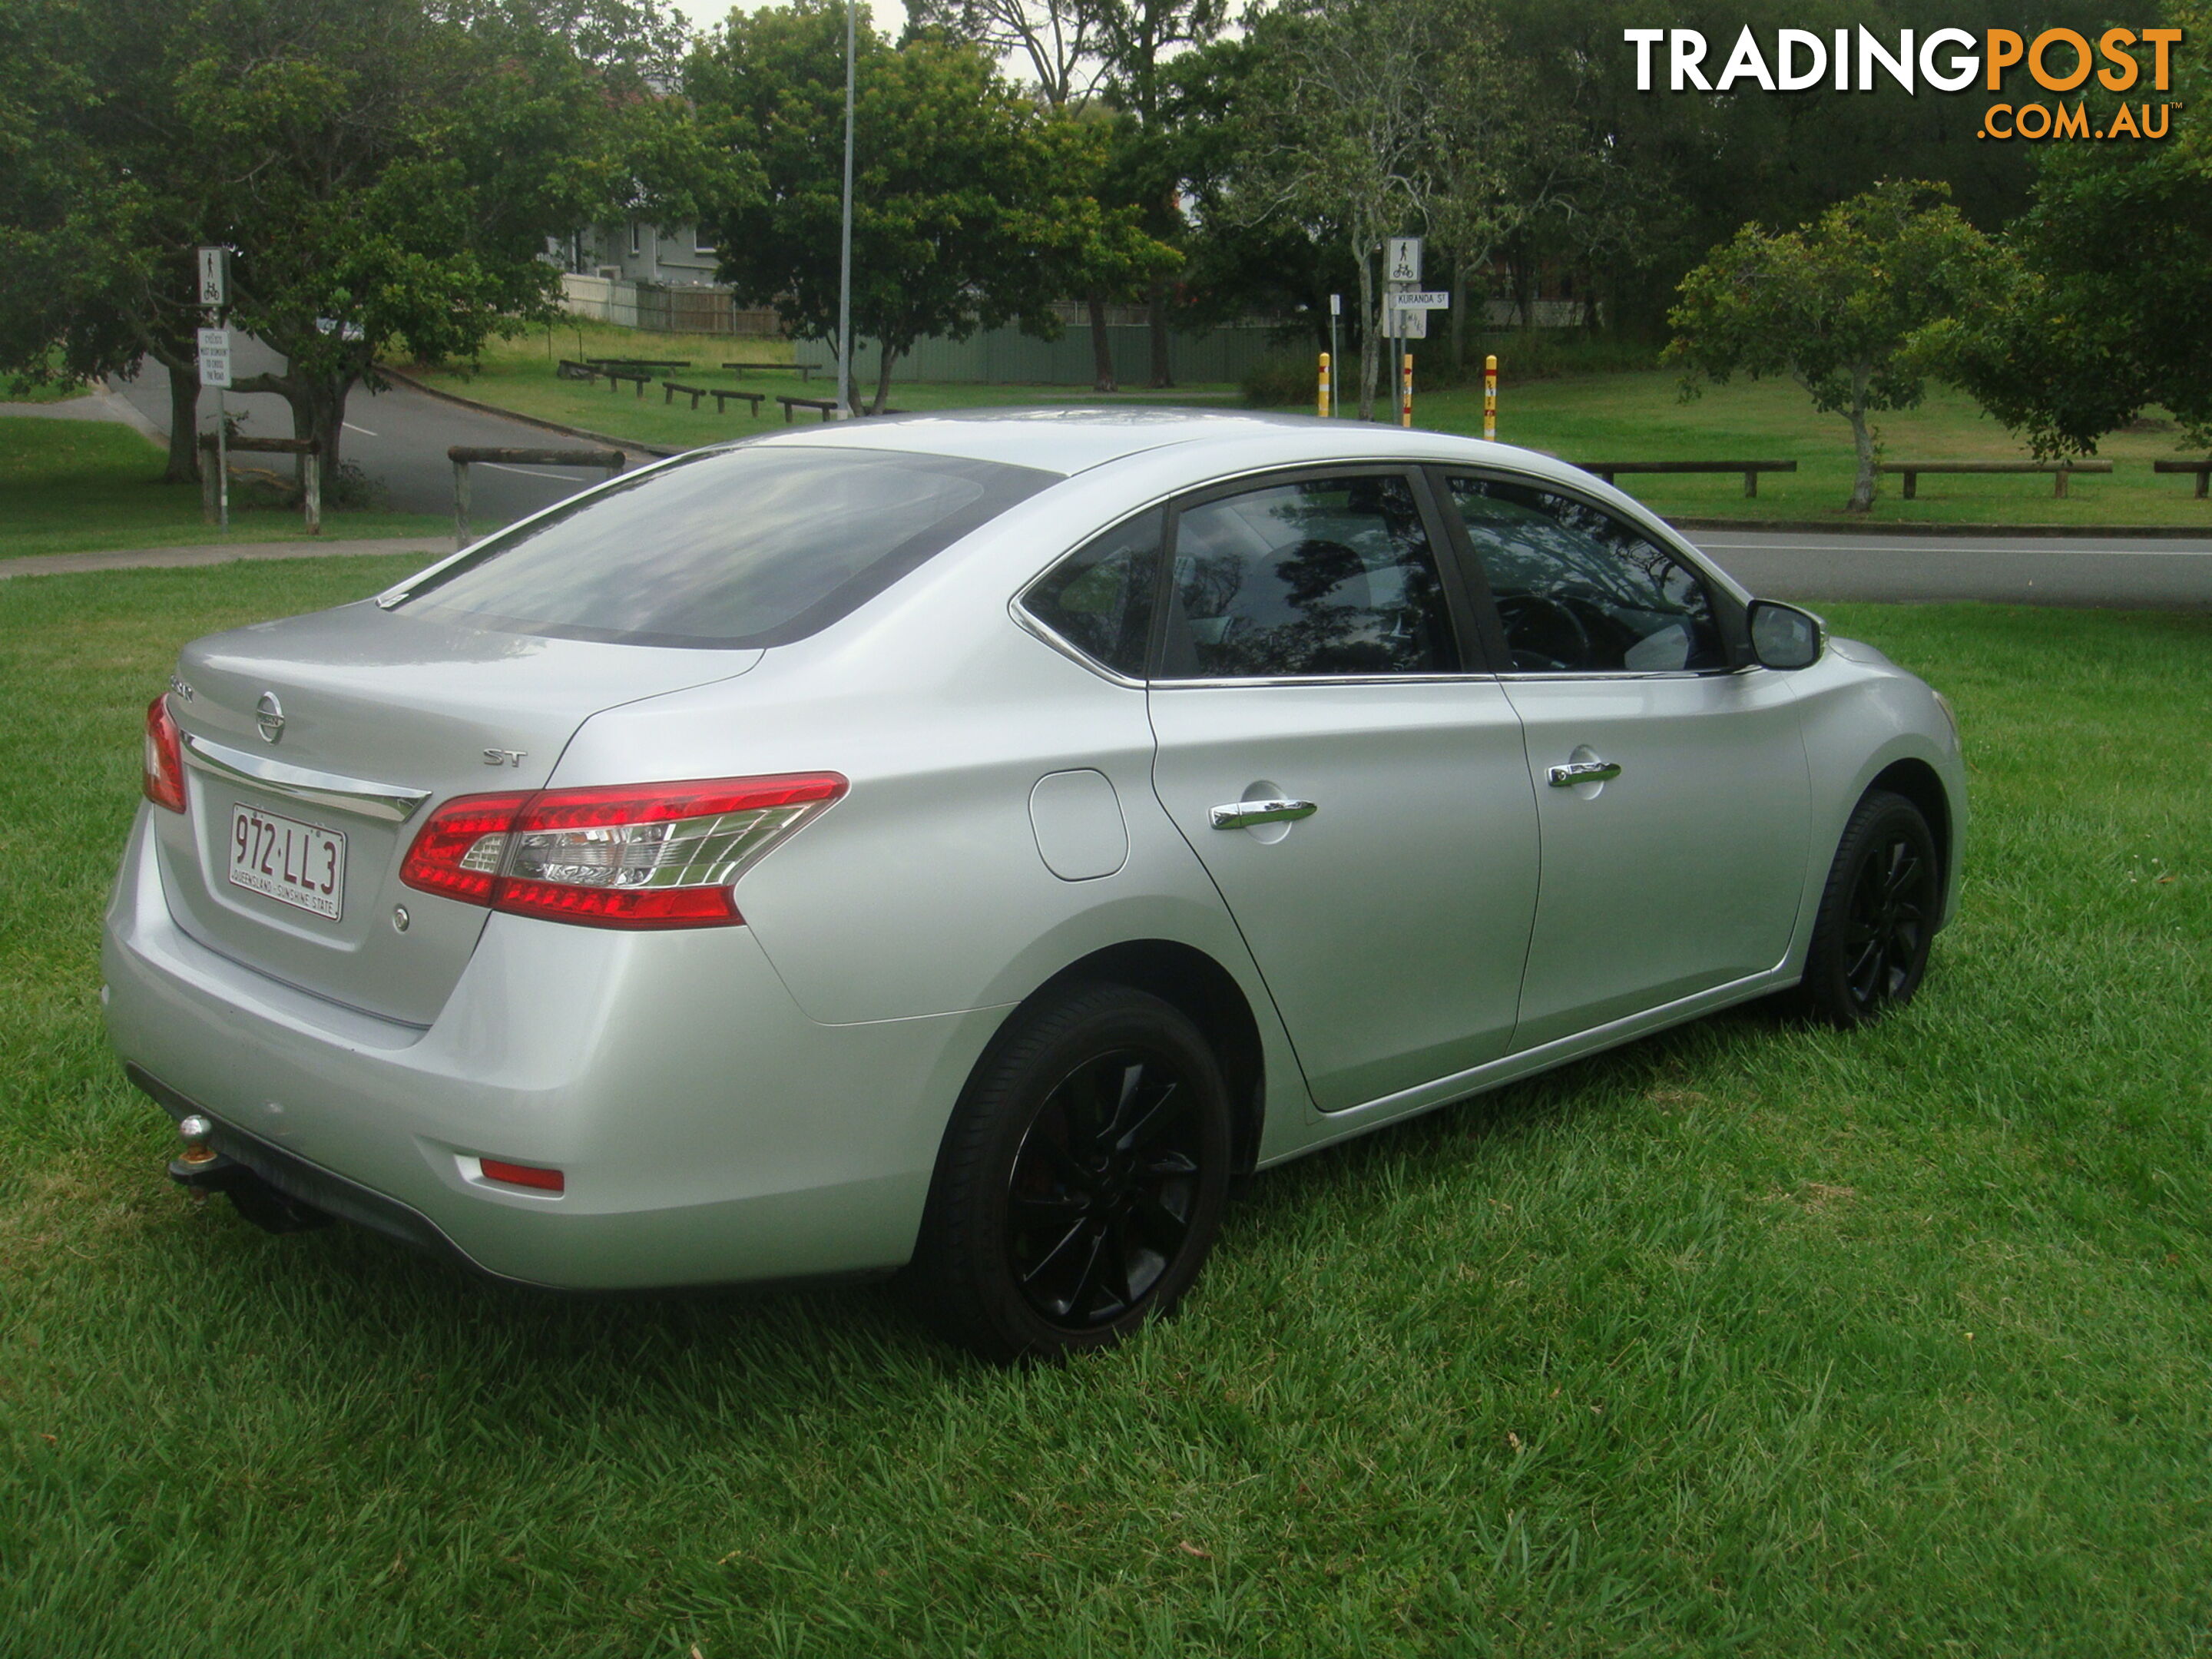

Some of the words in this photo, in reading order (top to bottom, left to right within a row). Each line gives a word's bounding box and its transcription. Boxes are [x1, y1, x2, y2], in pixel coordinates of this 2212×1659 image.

[1398, 294, 1434, 304] KURANDA
[1437, 293, 1445, 303] ST
[483, 748, 528, 767] ST
[232, 869, 273, 892] QUEENSLAND
[313, 896, 333, 914] STATE
